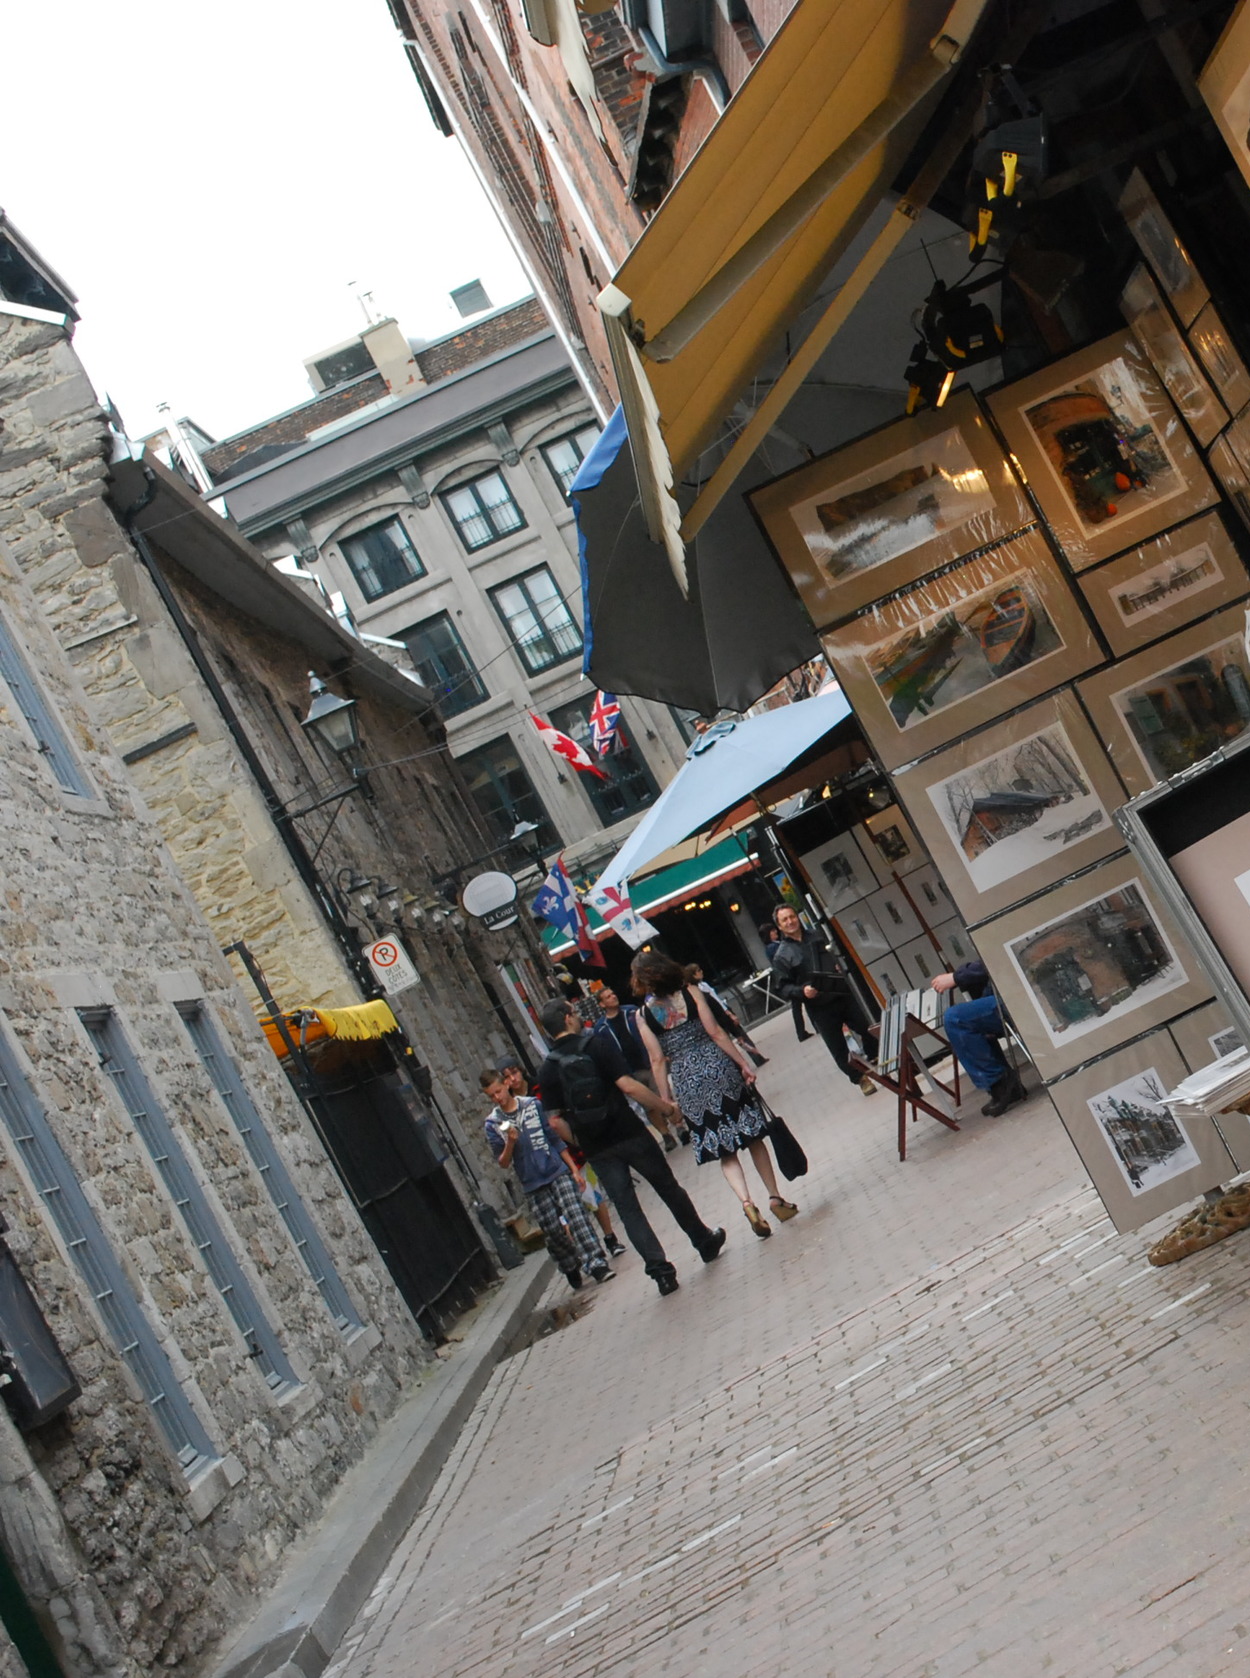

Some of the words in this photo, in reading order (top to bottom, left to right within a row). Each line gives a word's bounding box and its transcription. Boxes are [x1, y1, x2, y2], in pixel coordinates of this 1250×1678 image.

[483, 915, 495, 925] La
[495, 906, 514, 918] Cour
[524, 1100, 541, 1129] NEW
